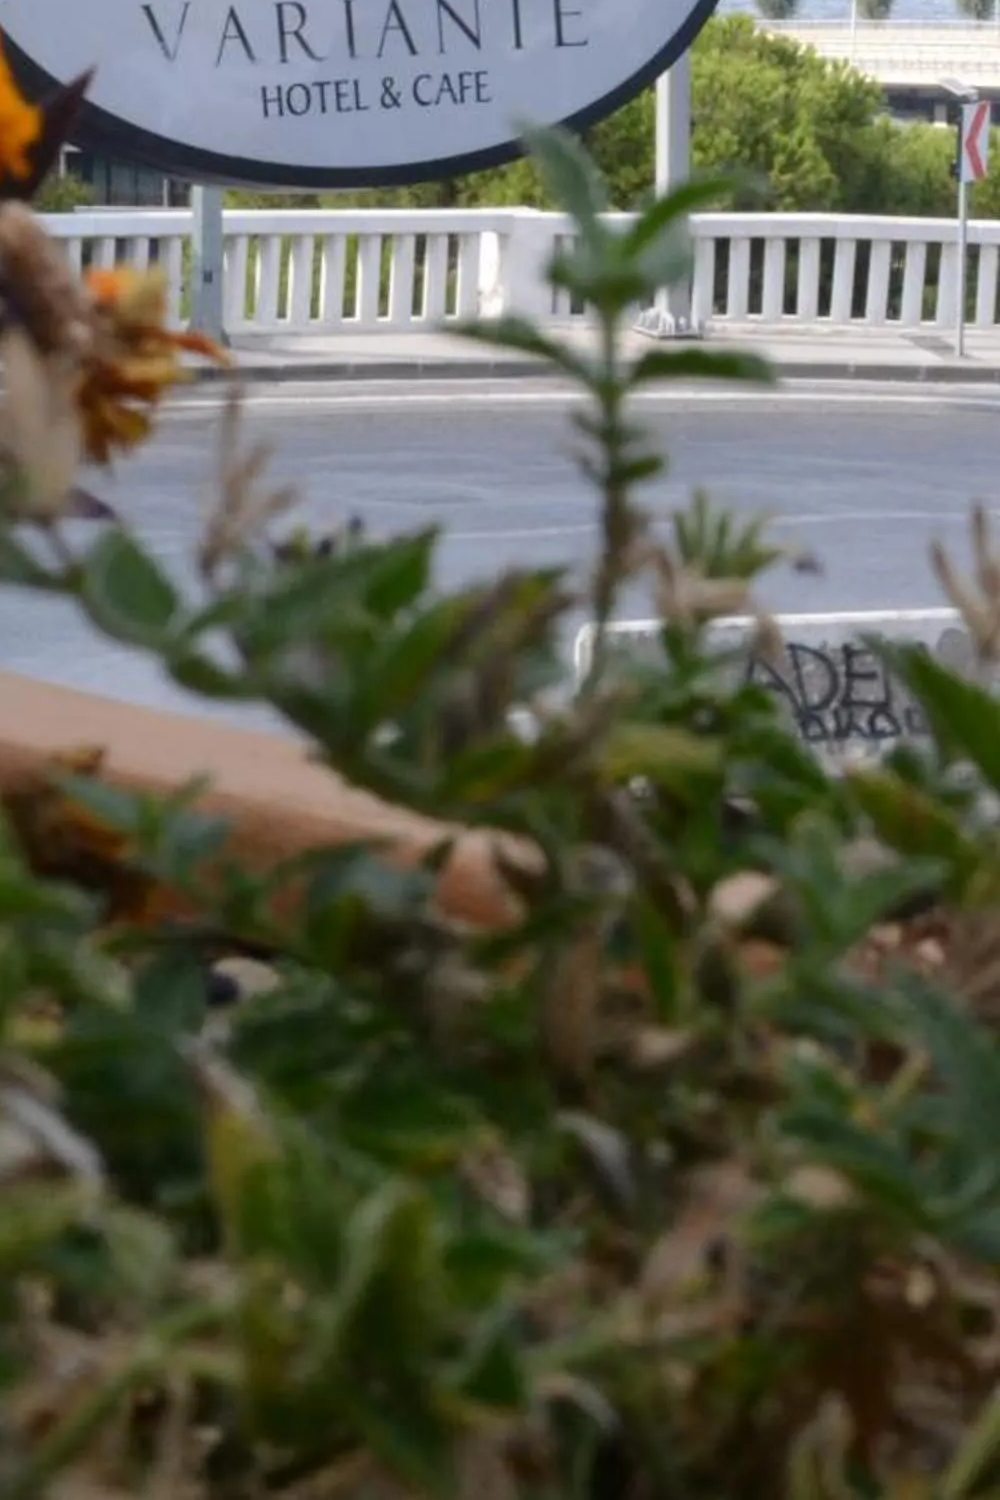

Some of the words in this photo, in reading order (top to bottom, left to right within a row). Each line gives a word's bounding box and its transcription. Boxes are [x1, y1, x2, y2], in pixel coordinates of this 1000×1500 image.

[261, 79, 370, 119] HOTEL
[379, 76, 403, 110] &
[412, 70, 493, 106] CAFE
